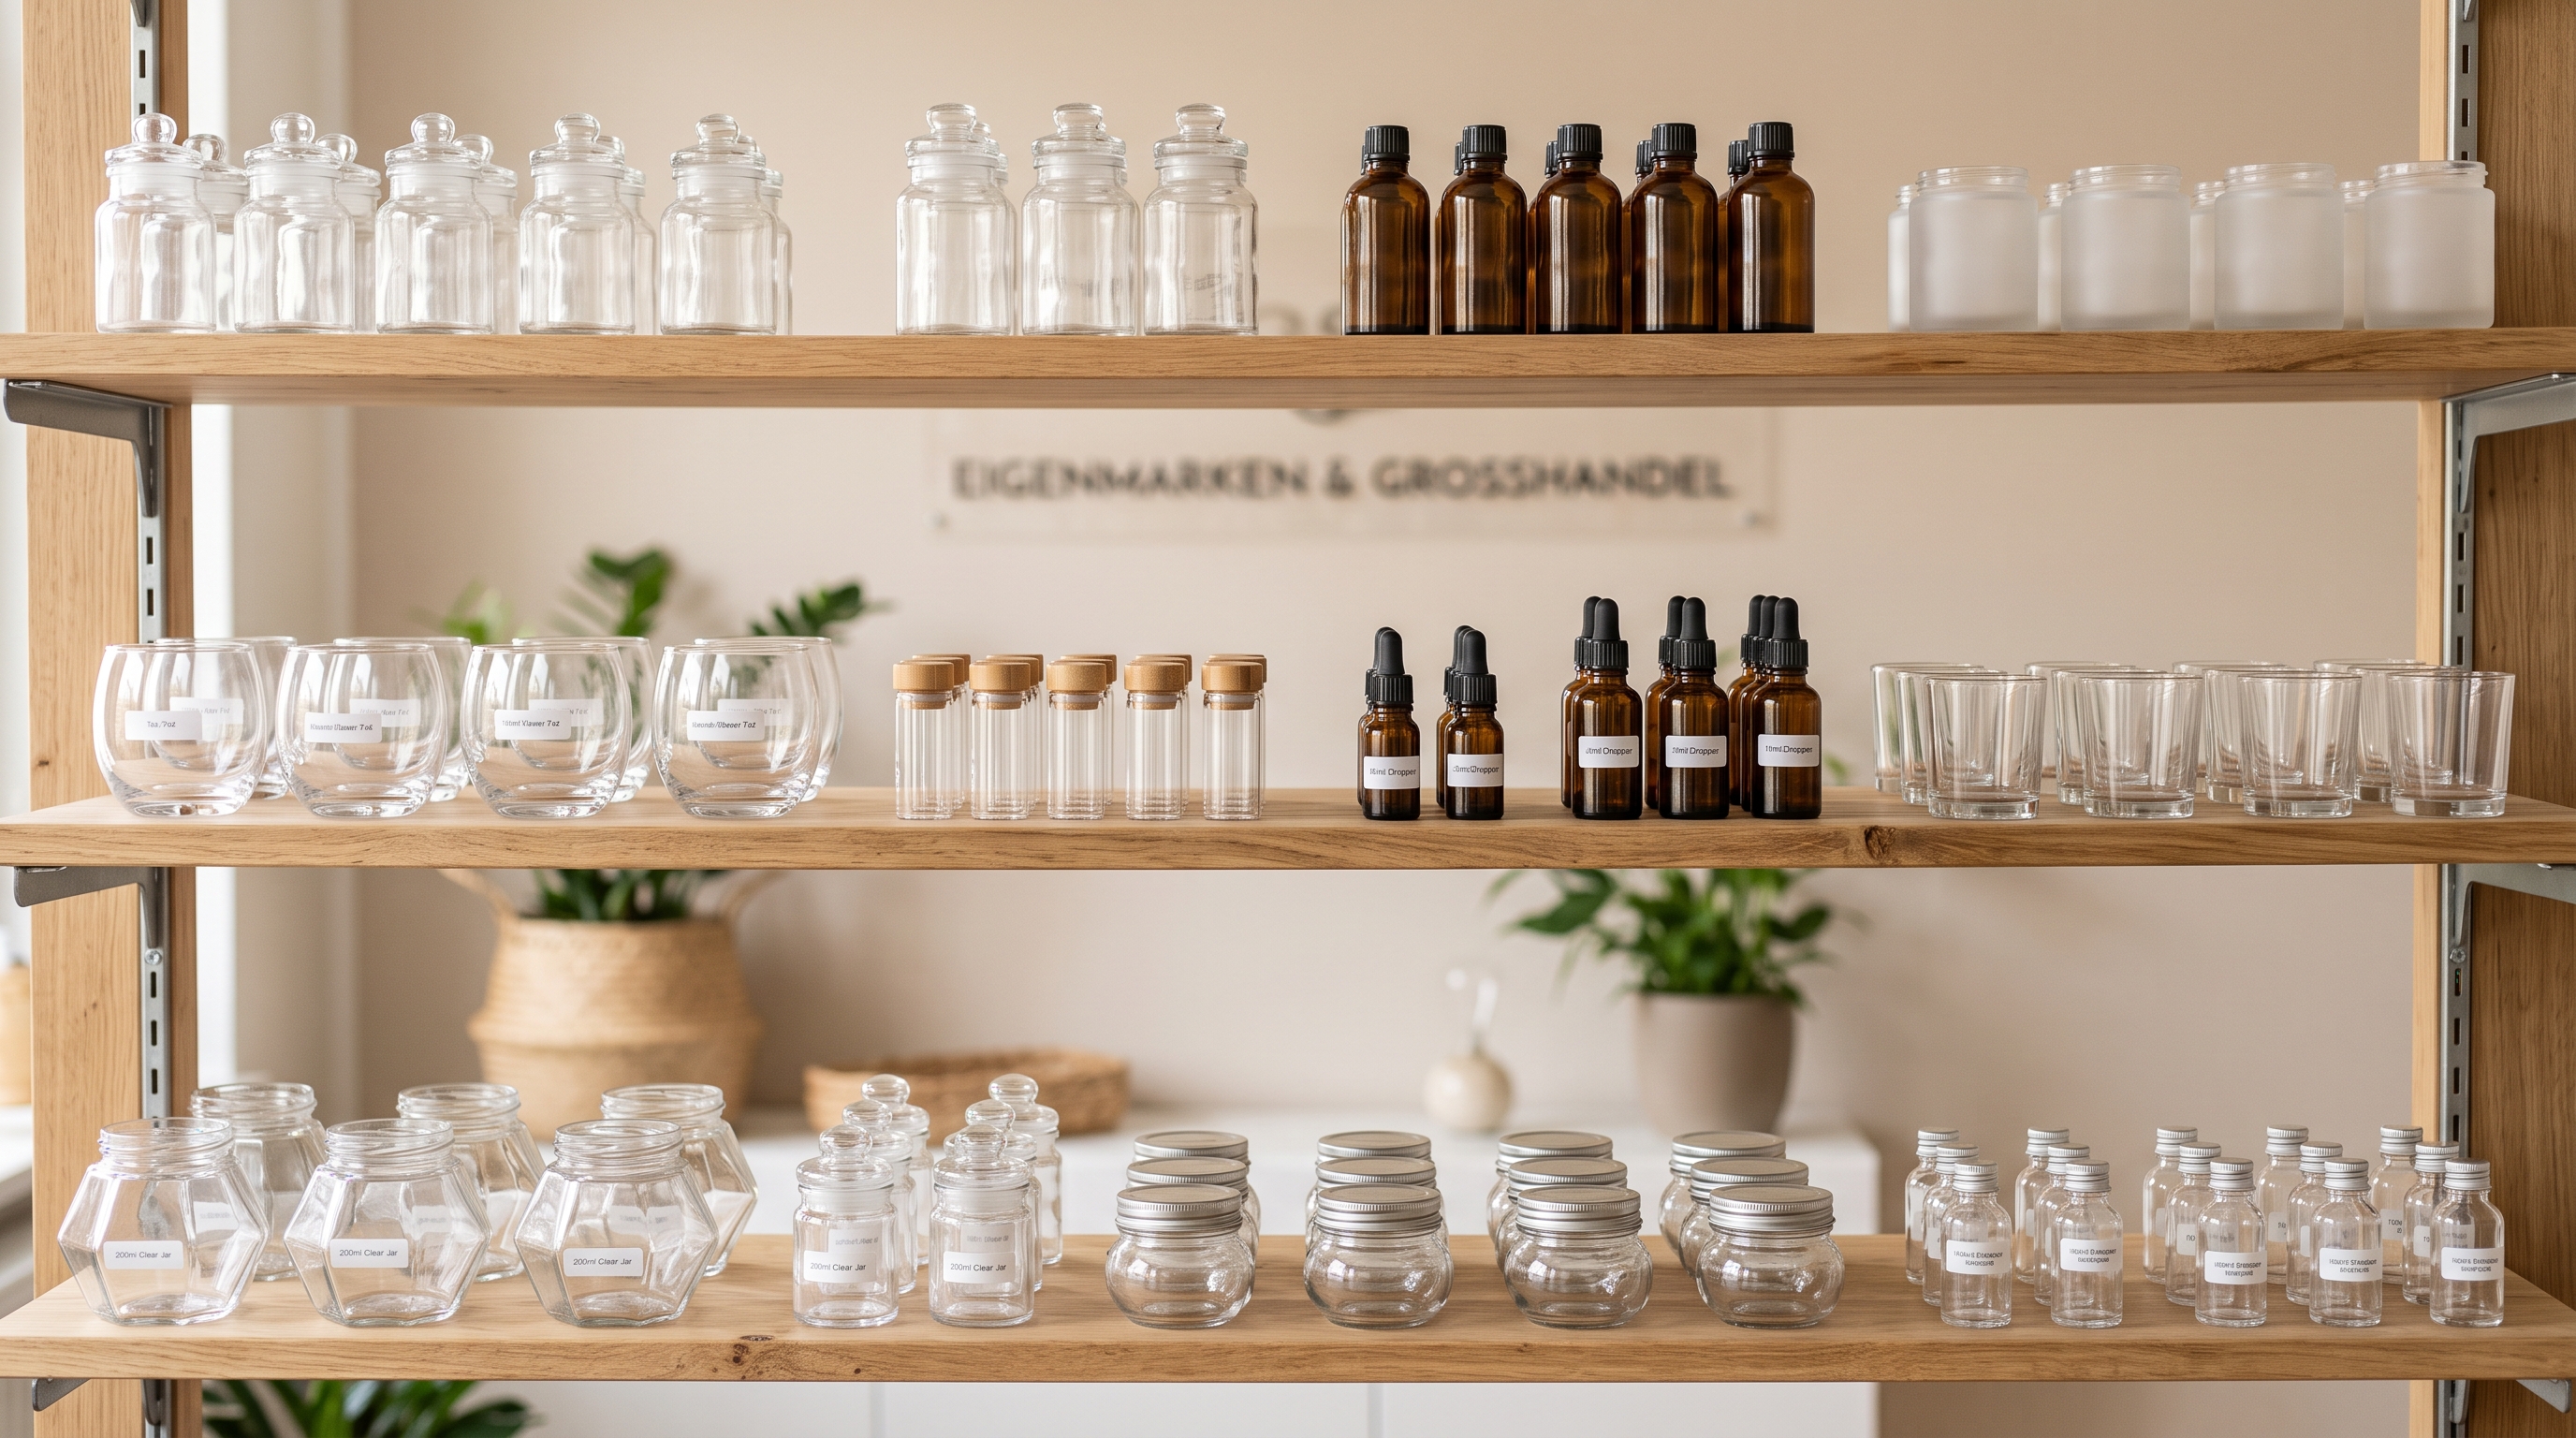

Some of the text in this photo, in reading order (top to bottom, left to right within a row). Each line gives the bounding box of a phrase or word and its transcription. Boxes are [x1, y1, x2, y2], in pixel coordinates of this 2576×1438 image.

[952, 457, 1733, 500] EIGENMARKEN & GROSSHANDEL
[597, 1257, 619, 1266] Clear
[832, 1263, 853, 1271] Clear
[855, 1263, 867, 1271] Jar
